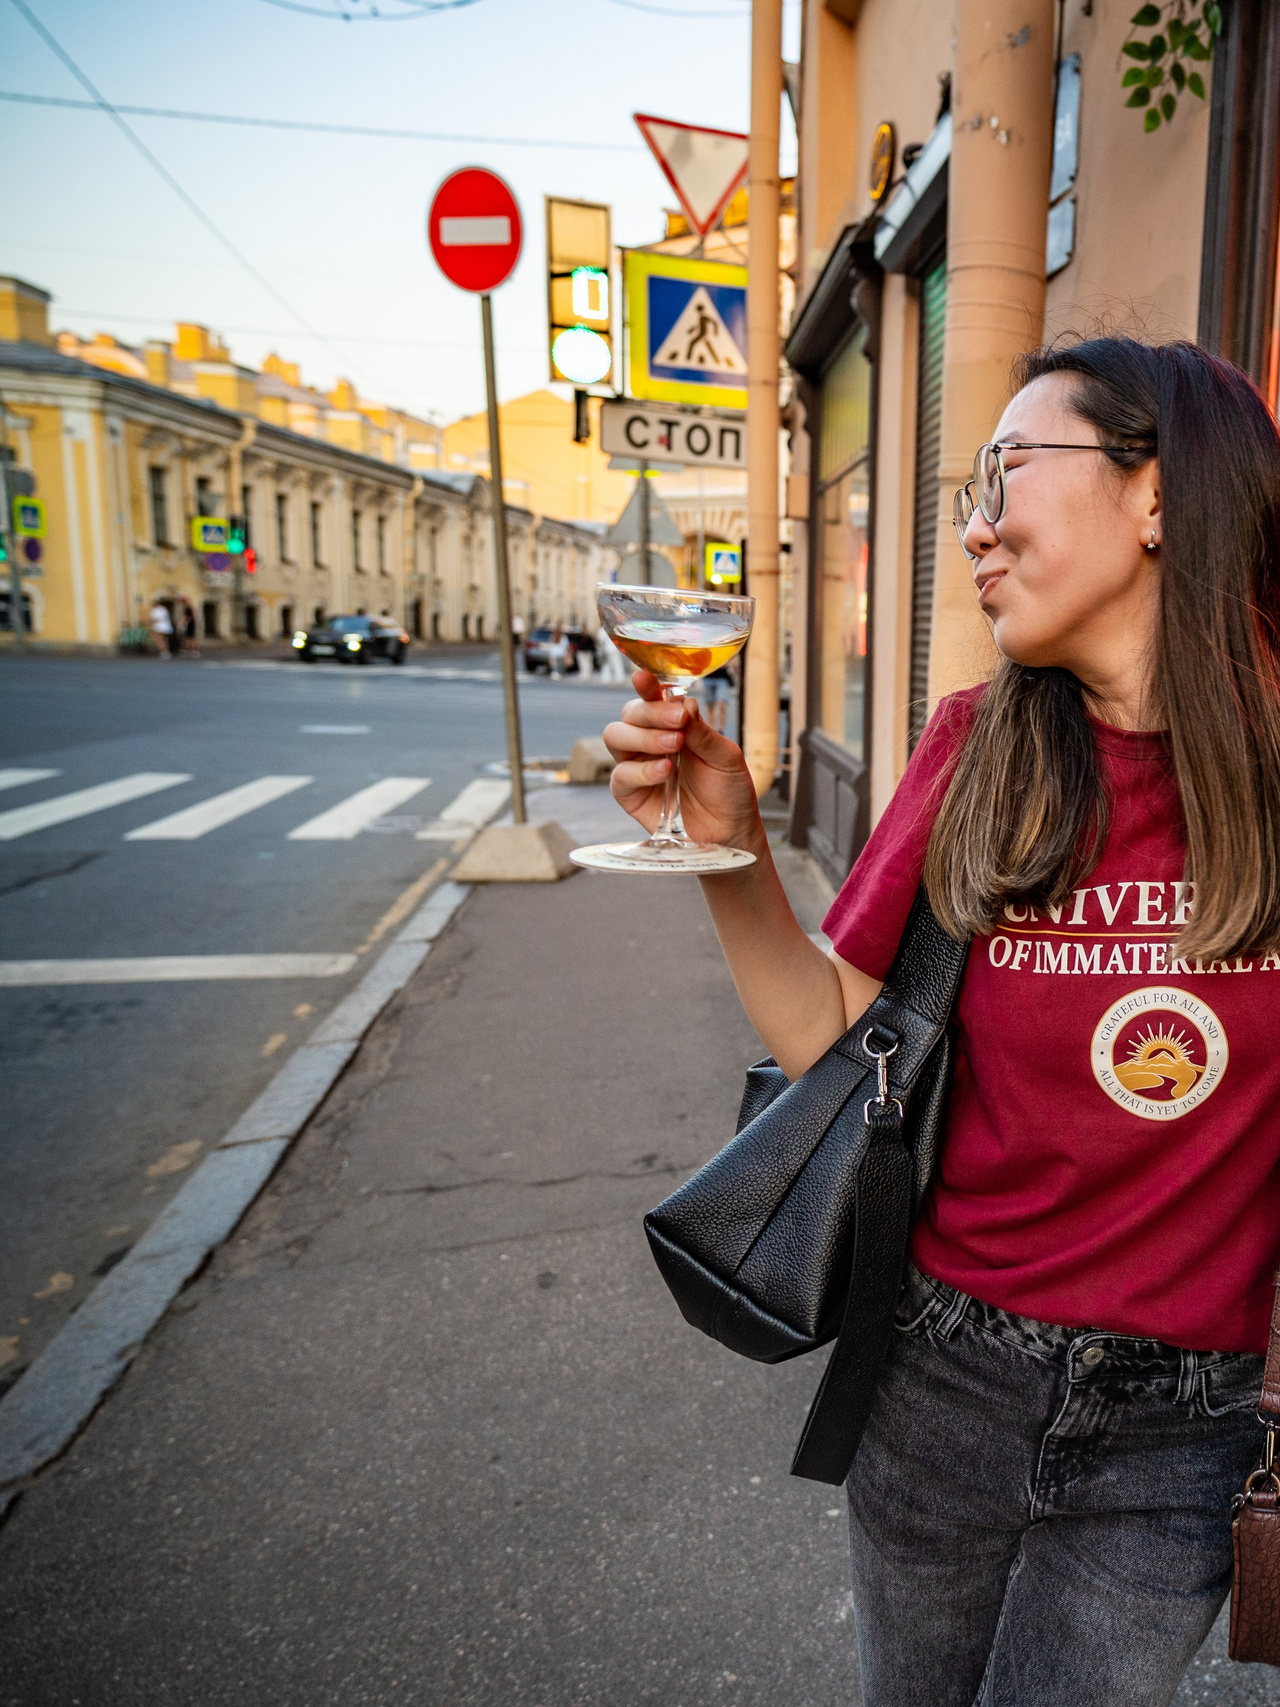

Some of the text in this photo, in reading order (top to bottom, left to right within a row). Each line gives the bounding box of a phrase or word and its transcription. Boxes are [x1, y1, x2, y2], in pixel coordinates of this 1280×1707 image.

[624, 414, 741, 460] СТОП
[988, 935, 1033, 971] OF
[1100, 992, 1220, 1041] GRATEFUL FOR ALL AND
[1099, 1066, 1221, 1116] ALL THAT IS YET TO COME
